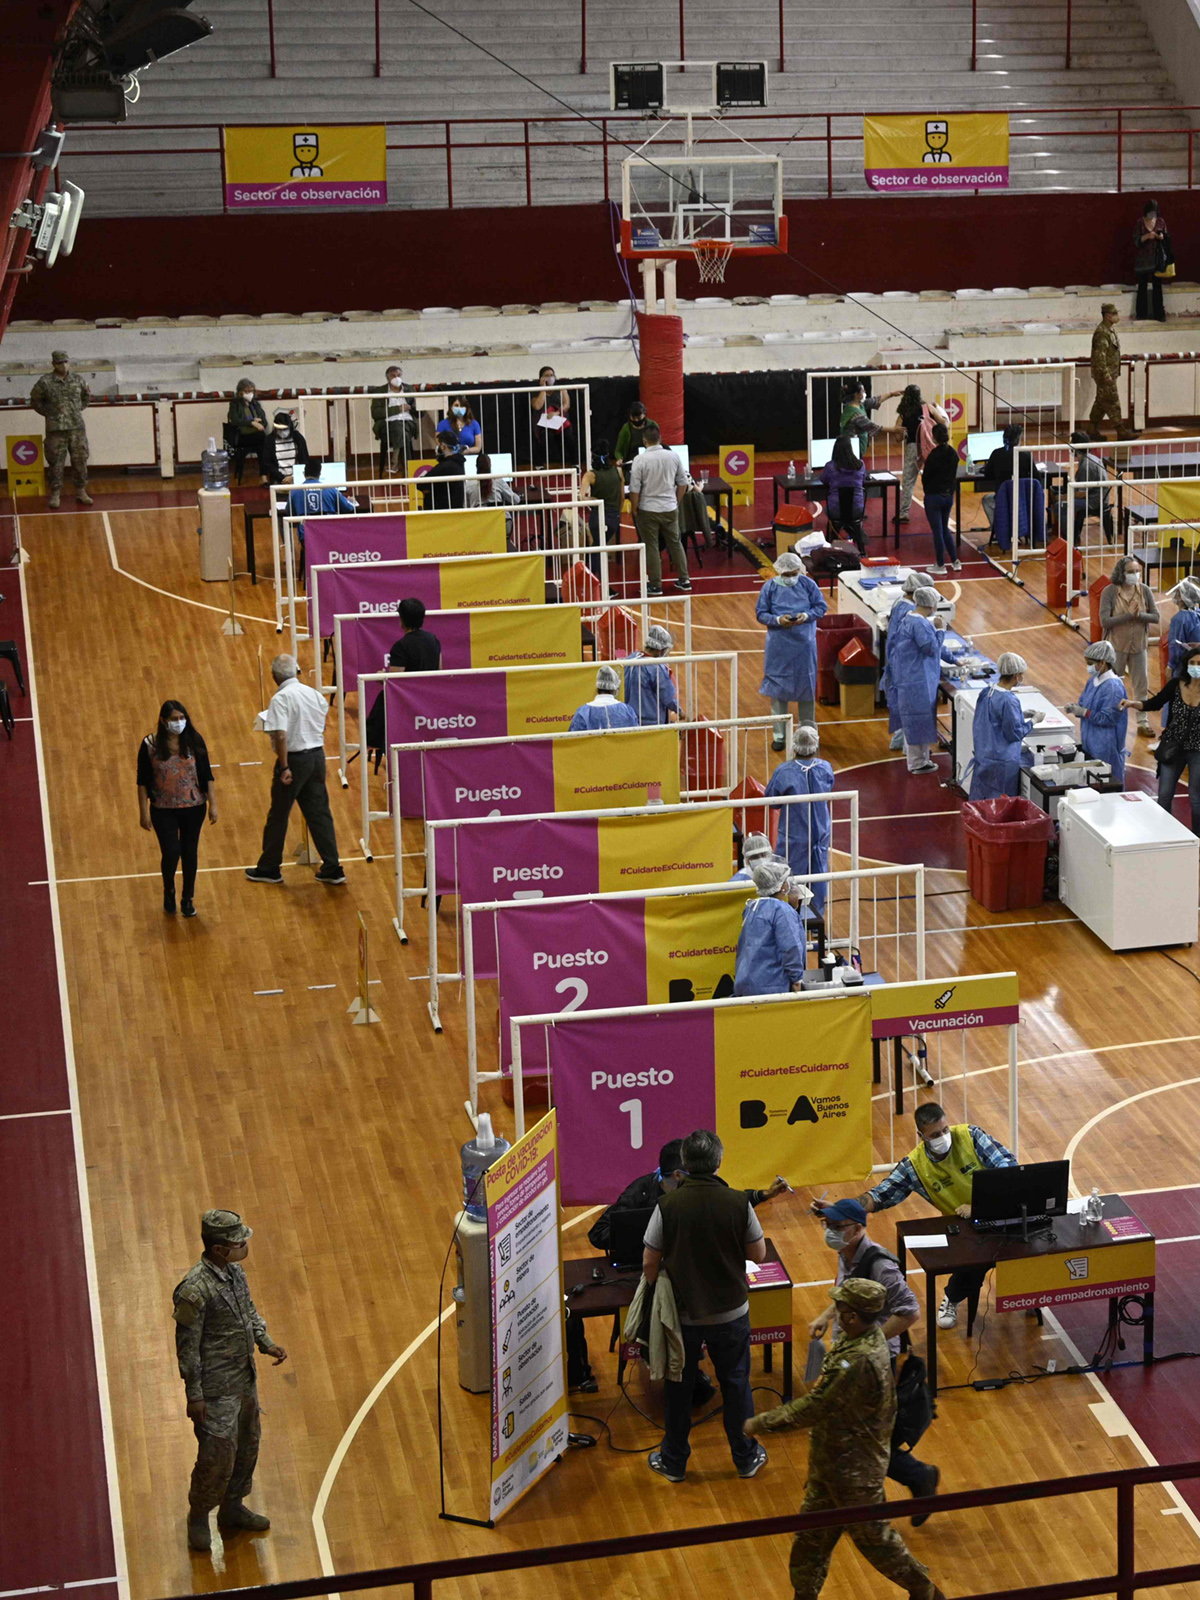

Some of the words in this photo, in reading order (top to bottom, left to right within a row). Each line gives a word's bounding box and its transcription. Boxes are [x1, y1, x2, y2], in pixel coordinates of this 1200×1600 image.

[872, 175, 910, 186] Sector
[912, 174, 928, 184] de
[931, 172, 1002, 184] observación
[234, 190, 277, 200] Sector
[281, 190, 298, 200] de
[301, 188, 380, 200] observación
[328, 550, 381, 564] Puesto
[359, 600, 402, 614] Puest
[458, 597, 530, 608] #CuidarteEsCuidarnos
[488, 652, 566, 662] #CuidarteEsCuidarnos
[415, 714, 476, 730] Puesto
[455, 785, 522, 802] Puesto
[574, 781, 662, 794] #CuidarteEsCuidarnos
[493, 864, 564, 883] Puesto
[620, 862, 714, 875] #CuidarteEsCuidarnos
[534, 948, 608, 970] Puesto
[555, 977, 588, 1014] 2
[909, 1013, 984, 1030] Vacunación
[740, 1062, 850, 1078] #CuidarteEsCuidarnos
[592, 1068, 674, 1090] Puesto
[811, 1096, 841, 1104] Vamos
[817, 1102, 850, 1112] Buenos
[822, 1110, 846, 1119] Aires
[619, 1098, 642, 1150] 1
[486, 1164, 506, 1188] Posta
[508, 1154, 516, 1168] de
[517, 1120, 553, 1158] vacunación
[514, 1214, 527, 1230] Sector
[528, 1208, 533, 1218] de
[516, 1259, 528, 1275] Sector
[529, 1253, 534, 1263] de
[1002, 1298, 1036, 1310] Sector
[1039, 1294, 1052, 1304] de
[1055, 1282, 1150, 1303] empadronamiento
[517, 1302, 530, 1318] Puesto
[531, 1296, 536, 1305] de
[517, 1303, 538, 1327] vacunación
[518, 1346, 530, 1363] Sector
[531, 1339, 537, 1350] de
[519, 1390, 531, 1406] Salida
